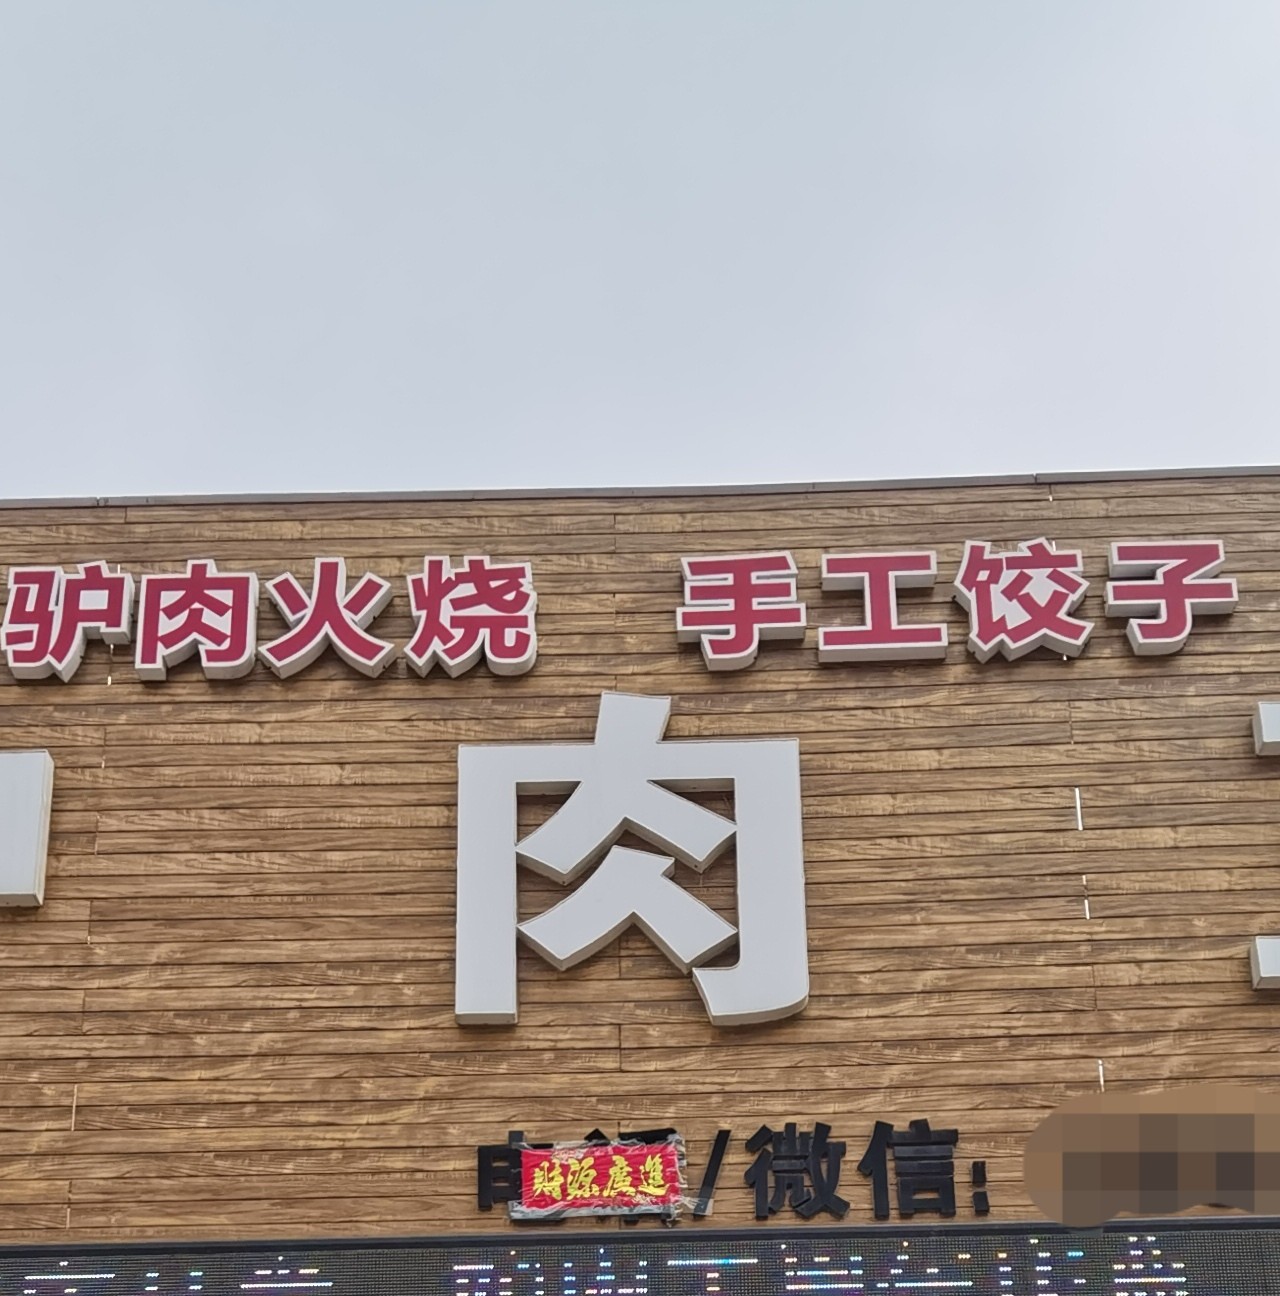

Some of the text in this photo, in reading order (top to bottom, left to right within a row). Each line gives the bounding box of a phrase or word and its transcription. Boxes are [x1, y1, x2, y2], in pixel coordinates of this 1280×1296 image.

[1, 538, 1238, 681] 驴肉火烧 手工饺子
